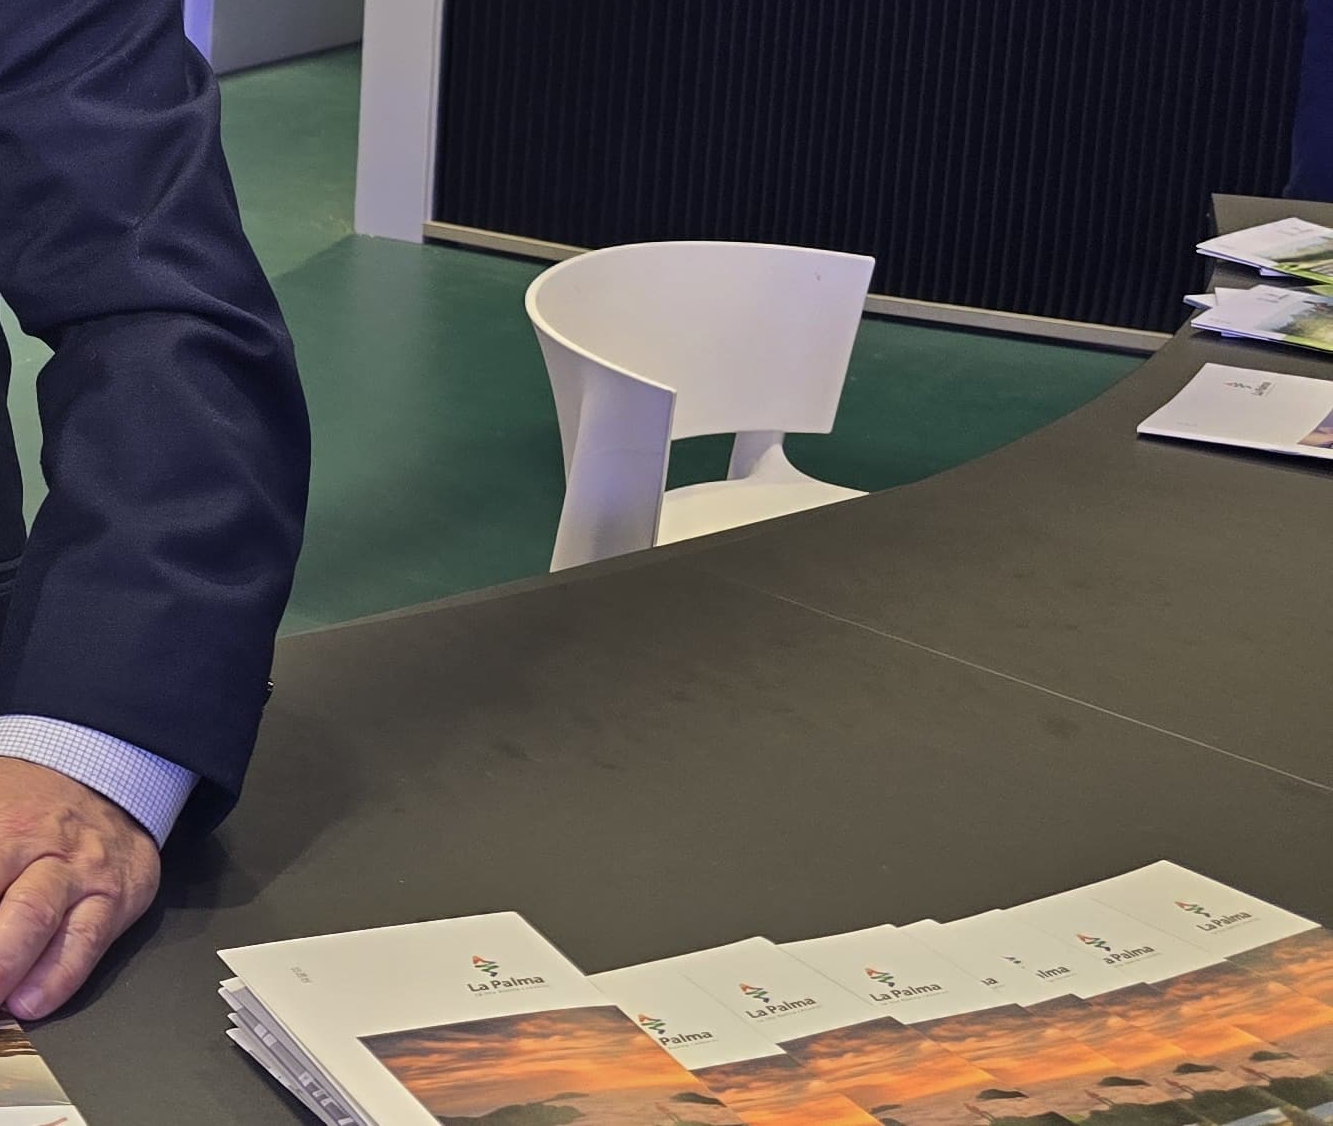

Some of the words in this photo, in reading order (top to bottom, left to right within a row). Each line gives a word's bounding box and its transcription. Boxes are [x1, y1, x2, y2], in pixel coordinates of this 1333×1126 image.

[1196, 923, 1217, 932] La
[1211, 912, 1253, 927] Palma
[1114, 945, 1155, 962] Palma
[467, 983, 490, 992] La
[490, 976, 545, 990] Palma
[869, 993, 892, 1002] La
[890, 983, 942, 998] Palma
[745, 1008, 768, 1019] La
[765, 996, 817, 1014] Palma
[658, 1030, 714, 1046] Palma
